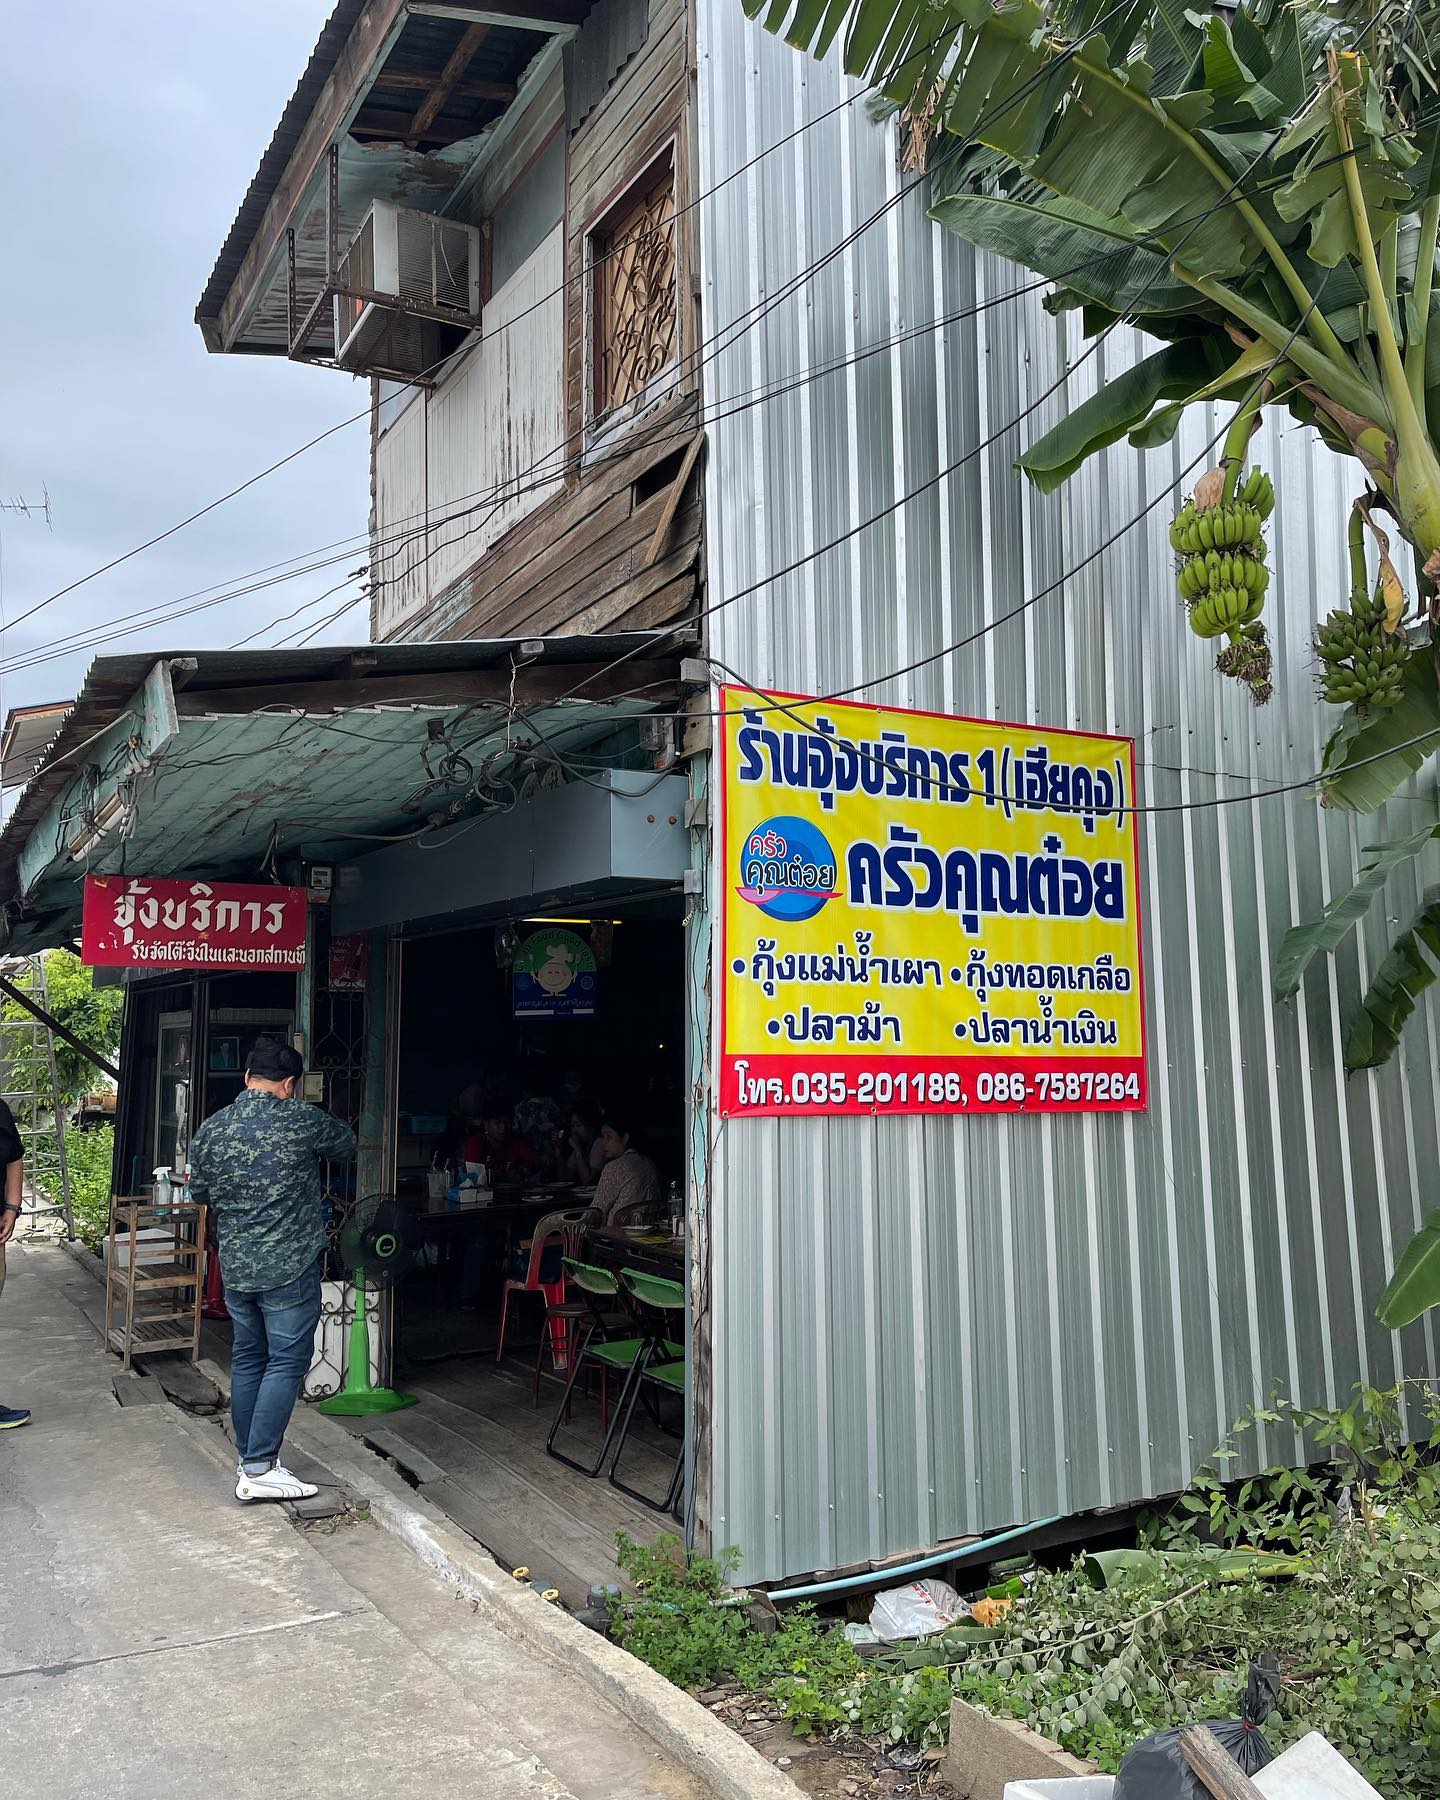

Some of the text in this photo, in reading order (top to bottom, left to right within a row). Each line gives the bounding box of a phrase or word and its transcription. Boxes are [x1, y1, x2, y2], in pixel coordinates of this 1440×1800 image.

[750, 830, 787, 857] ครัว
[747, 855, 834, 896] คุณต๋อย
[847, 825, 1125, 934] ครัวคุณต๋อย
[966, 949, 1131, 1002] กุ้งทอดเกลือ
[783, 1001, 901, 1042] ปลาม้า
[969, 995, 1118, 1044] ปลาน้ำเงิน
[976, 1072, 1141, 1103] 086-7587264
